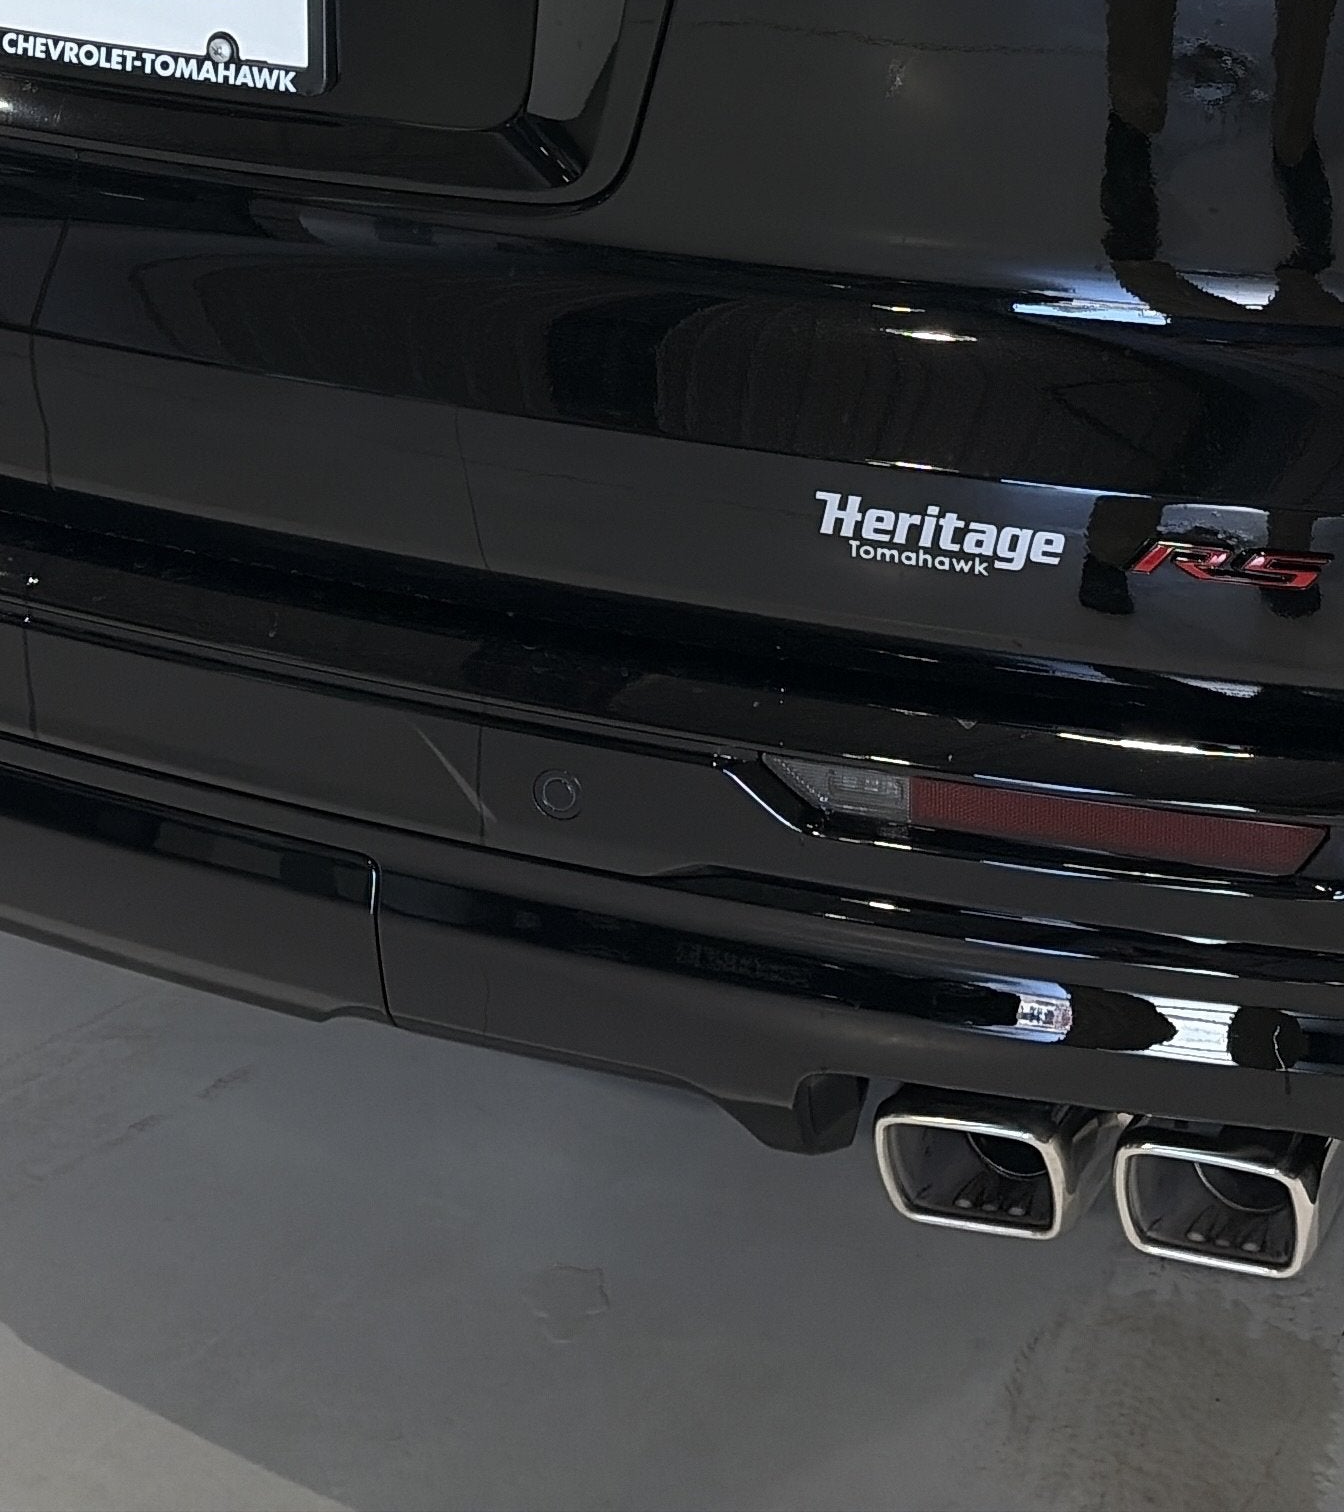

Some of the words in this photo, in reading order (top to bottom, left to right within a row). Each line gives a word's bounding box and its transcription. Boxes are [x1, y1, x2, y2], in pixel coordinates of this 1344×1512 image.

[2, 32, 297, 93] CHEVROLET-TOMAHAWK
[815, 490, 1066, 571] Heritage
[848, 539, 990, 577] Tomahawk
[1124, 535, 1336, 591] RS
